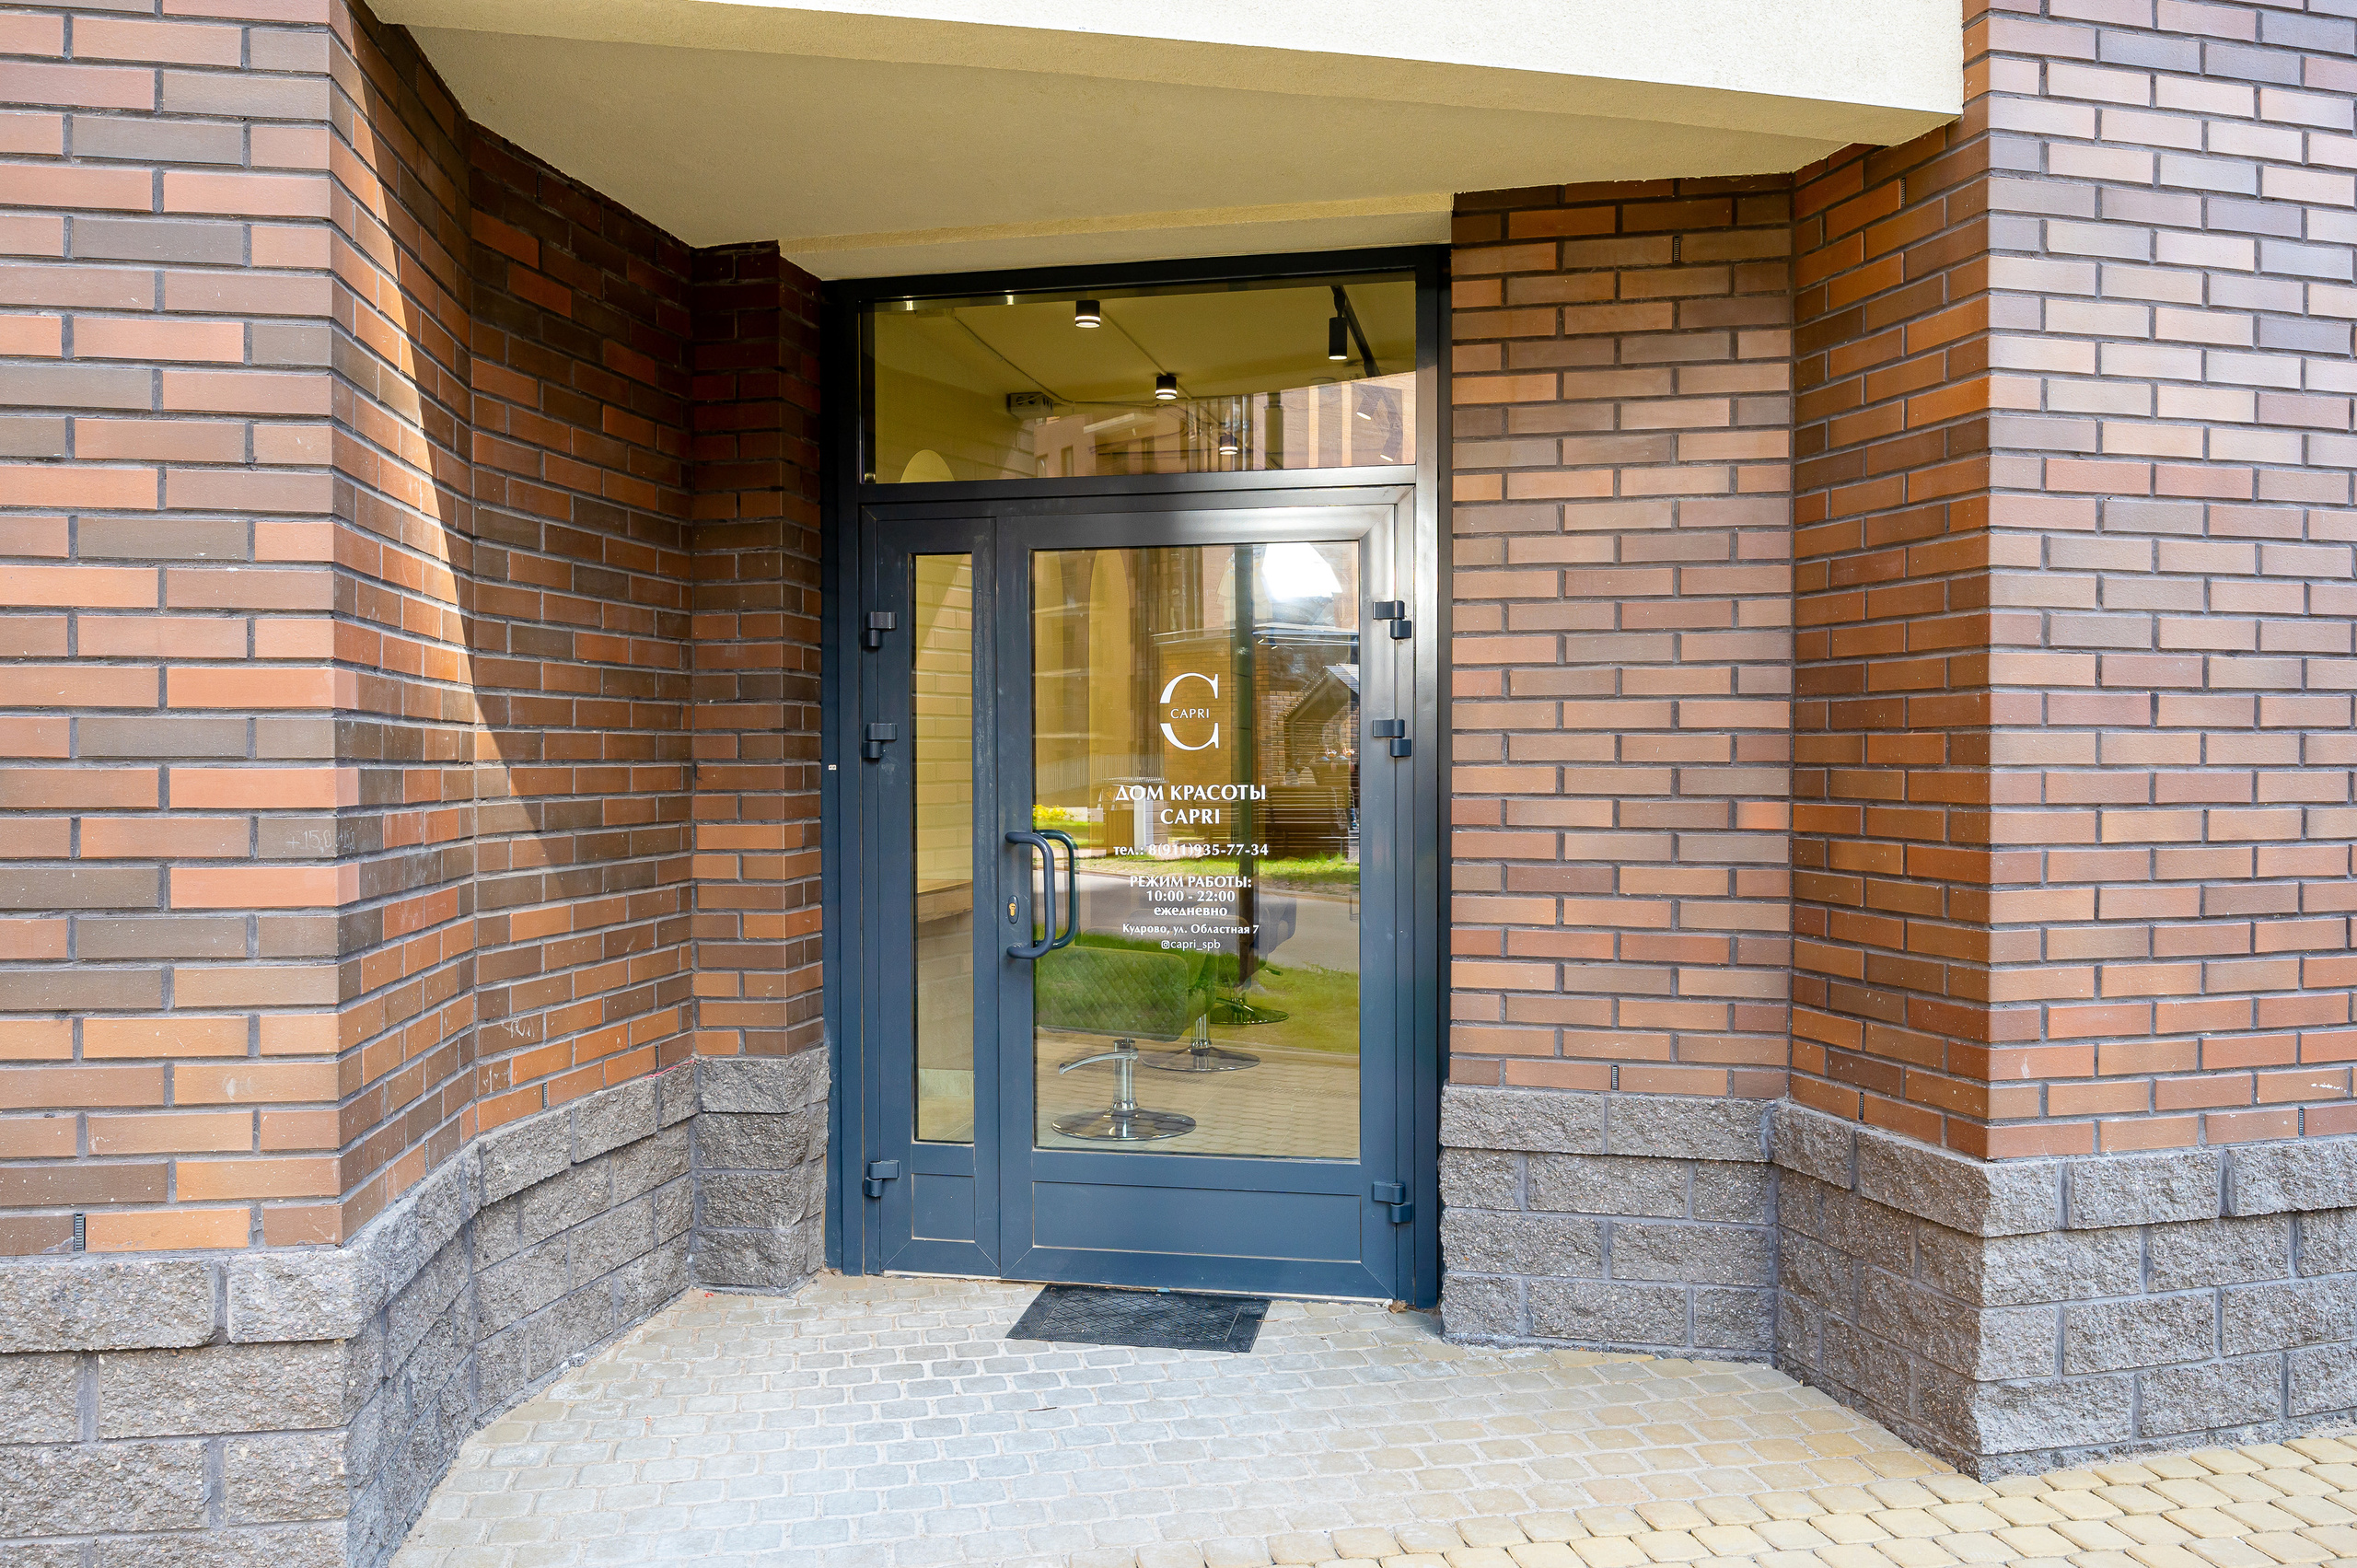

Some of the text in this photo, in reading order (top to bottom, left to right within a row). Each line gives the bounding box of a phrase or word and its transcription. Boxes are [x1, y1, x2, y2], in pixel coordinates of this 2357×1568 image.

[1170, 708, 1210, 719] CAPRI
[1115, 784, 1266, 801] ДОМ КРАСОТЫ
[1160, 808, 1220, 825] CAPRI
[1113, 842, 1269, 857] тел.: 8(911)935-77-34
[1130, 876, 1252, 889] РЕЖИМ РАБОТЫ:
[1146, 890, 1184, 902] 10:00
[1197, 890, 1236, 902] 22:00
[1154, 906, 1228, 917] ежедневно
[1122, 923, 1260, 935] Кудрово, ул. Областная 7
